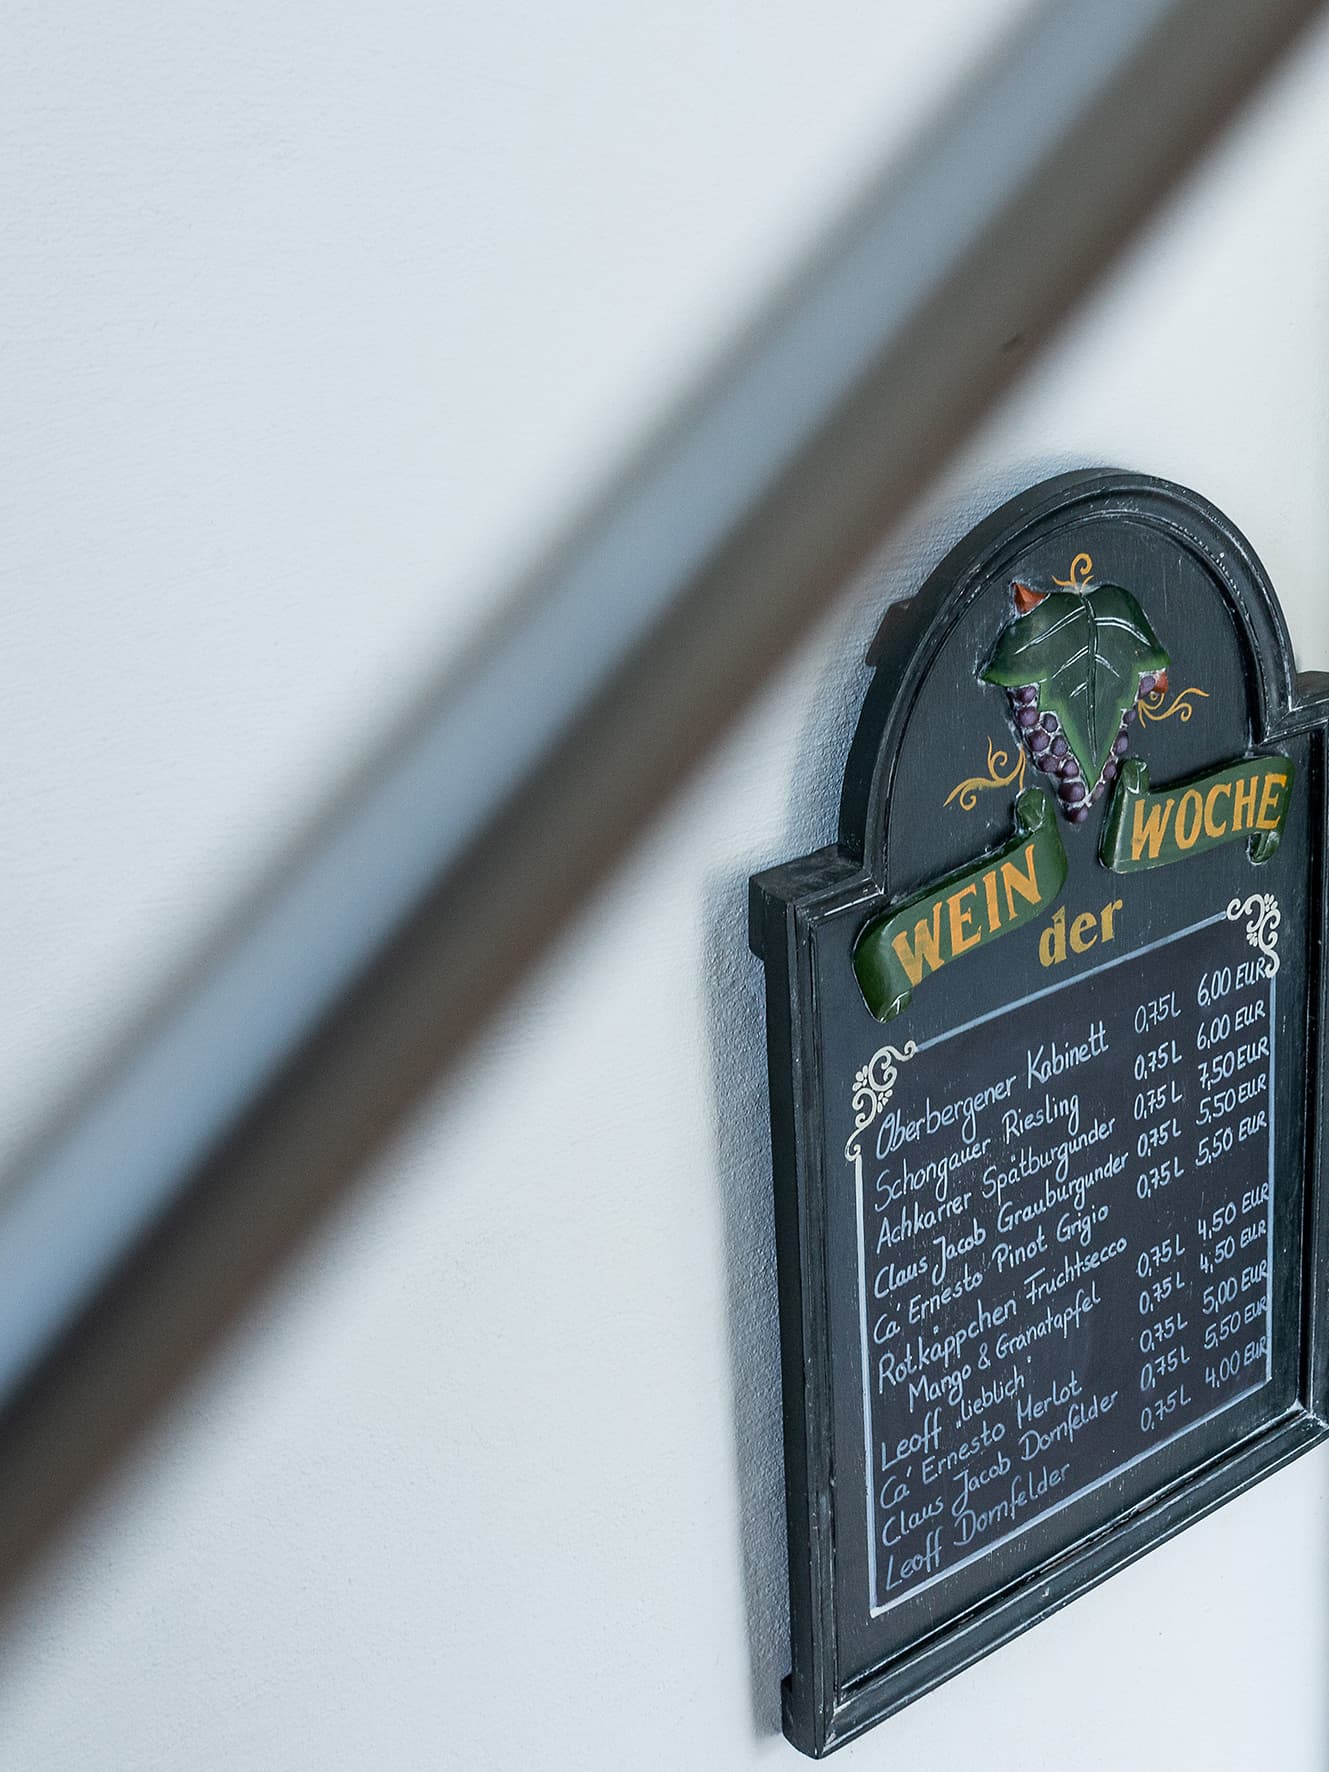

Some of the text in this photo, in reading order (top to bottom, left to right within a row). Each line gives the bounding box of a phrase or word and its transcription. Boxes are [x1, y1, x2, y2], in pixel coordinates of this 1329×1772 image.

[891, 843, 1042, 988] WEIN
[1130, 772, 1288, 862] WOCHE
[1038, 898, 1124, 968] der
[874, 1139, 991, 1212] Schongauer
[1001, 1094, 1080, 1144] Riesling
[1197, 1014, 1231, 1050] 6,00
[1235, 999, 1266, 1031] EUR
[876, 1076, 1017, 1160] Oberbergener
[1026, 1021, 1110, 1089] Kabinett
[1197, 967, 1231, 1006] 6,00
[1235, 957, 1266, 990] EUR
[876, 1191, 972, 1255] Achkarrer
[982, 1117, 1116, 1206] Spätburgunder
[1198, 1051, 1235, 1091] 7,50
[1236, 1036, 1269, 1070] EUR
[874, 1256, 928, 1299] Claus
[932, 1218, 987, 1286] Jacob
[997, 1152, 1129, 1232] Grauburgunder
[1196, 1088, 1236, 1125] 5,50
[1238, 1073, 1267, 1104] EUR
[878, 1298, 1017, 1394] Rotkäppchen
[1024, 1237, 1128, 1305] Fruchtsecco
[1198, 1201, 1237, 1240] 4,50
[1241, 1182, 1269, 1214] EUR
[908, 1263, 983, 1324] Ernesto
[992, 1225, 1048, 1273] Pinot
[1056, 1204, 1109, 1246] Grigio
[1195, 1127, 1233, 1166] 5,50
[1238, 1110, 1267, 1141] EUR
[881, 1406, 942, 1472] Leoff
[1199, 1236, 1236, 1273] 4,50
[1240, 1219, 1267, 1248] EUR
[881, 1496, 944, 1547] Claus
[951, 1450, 1012, 1517] Jacob
[1018, 1390, 1119, 1461] Dornfelder
[1204, 1311, 1241, 1350] 5,50
[1244, 1296, 1268, 1324] EUR
[908, 1281, 1101, 1413] Mango & Granatapfel
[922, 1420, 1006, 1485] Ernesto
[1017, 1370, 1083, 1429] Merlot
[1202, 1277, 1238, 1315] 5,00
[1241, 1259, 1269, 1292] EUR
[885, 1525, 942, 1592] Leoff
[953, 1463, 1070, 1546] Dornfelder
[1205, 1350, 1241, 1388] 4,00
[1243, 1335, 1267, 1366] EUR
